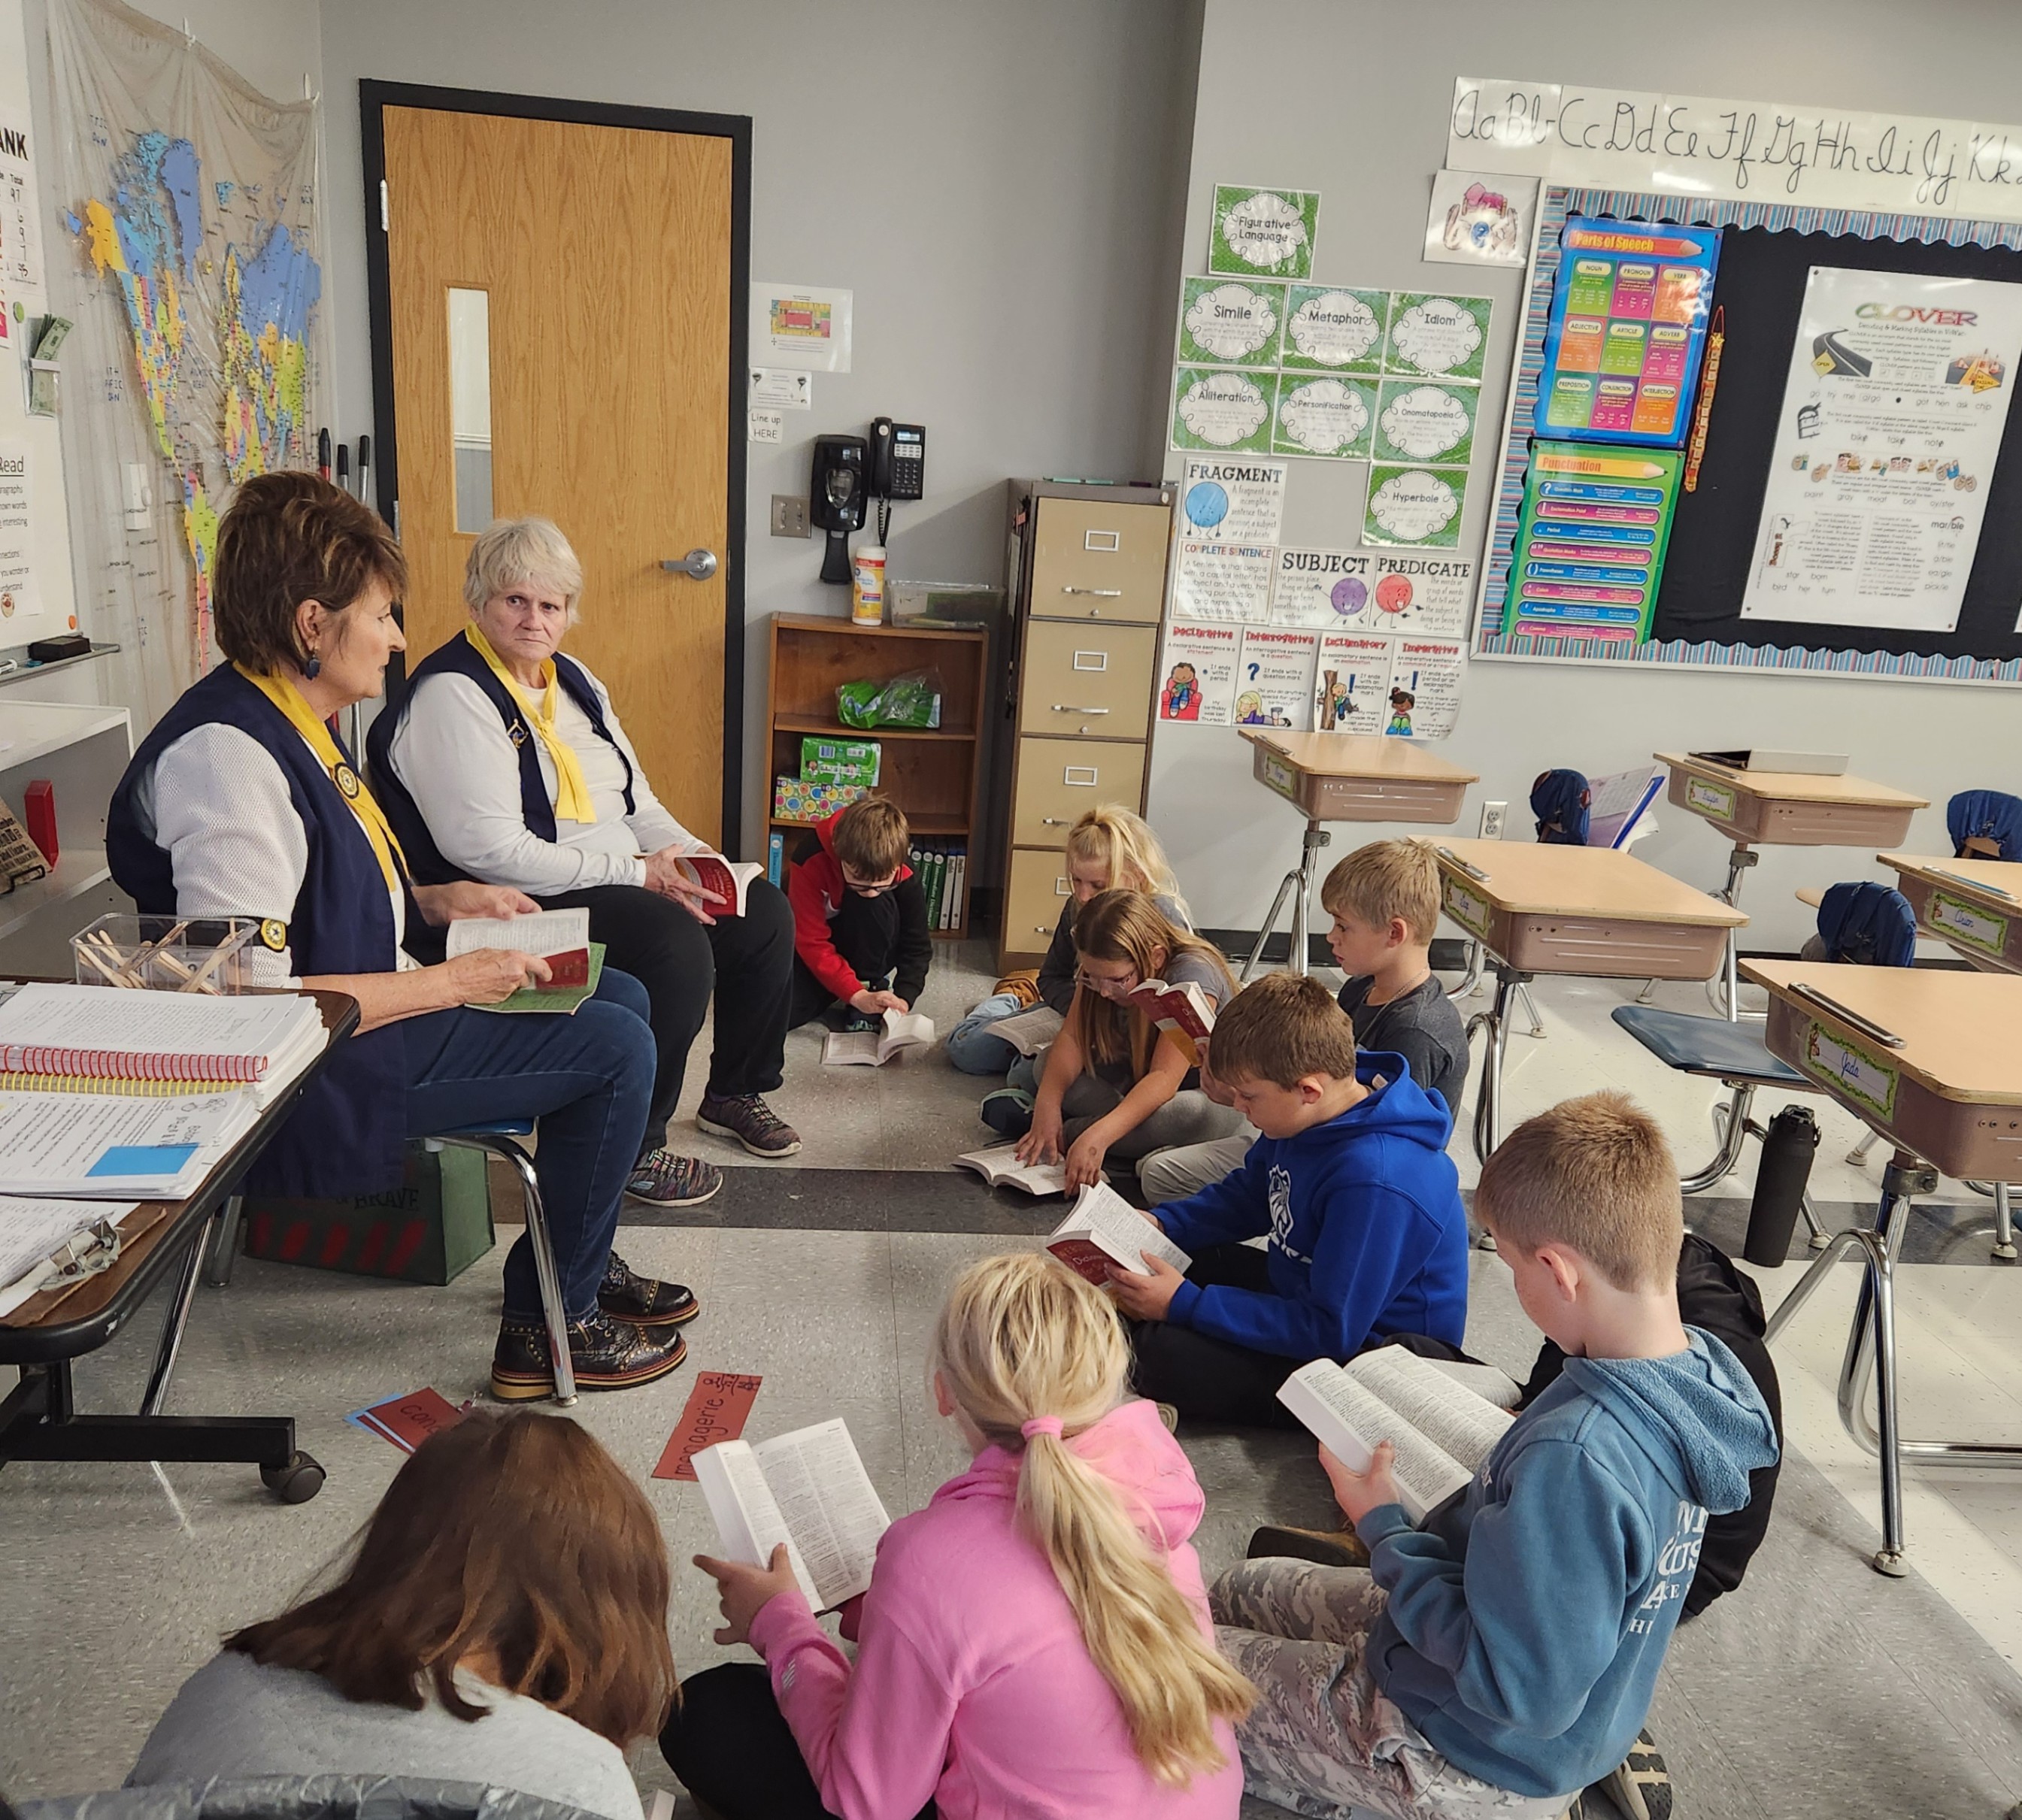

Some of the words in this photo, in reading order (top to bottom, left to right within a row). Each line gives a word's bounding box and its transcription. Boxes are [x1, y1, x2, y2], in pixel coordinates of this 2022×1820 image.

[1238, 216, 1291, 231] Figurative
[1238, 229, 1289, 244] Language
[1575, 232, 1603, 247] Parts
[1604, 235, 1615, 248] of
[1616, 236, 1654, 252] Speech
[1623, 268, 1652, 276] PRONOUN
[1214, 304, 1252, 319] Simile
[1308, 310, 1365, 326] Metaphor
[1855, 301, 1978, 326] CLOVER
[1424, 313, 1457, 326] Idiom
[1570, 323, 1599, 332] ADJECTIVE
[1616, 326, 1638, 335] ARTICLE
[1558, 380, 1590, 389] PREPOSITION
[1601, 383, 1632, 392] CONJUNCTION
[1198, 390, 1254, 403] Alliteration
[1643, 387, 1675, 396] INTERJECTION
[1297, 399, 1353, 411] Personification
[751, 413, 768, 422] Line
[771, 416, 781, 425] up
[1401, 408, 1454, 419] Onomatopoeia
[753, 429, 778, 439] HERE
[1542, 456, 1602, 472] Punctuation
[1189, 465, 1282, 483] FRAGMENT
[1238, 486, 1265, 496] fragment
[1240, 498, 1270, 506] incomplete
[1392, 492, 1439, 504] Hyperbole
[1231, 508, 1255, 516] sentence
[1257, 520, 1277, 529] subject
[1282, 552, 1370, 574] SUBJECT
[1378, 558, 1471, 577] PREDICATE
[1206, 571, 1232, 580] captal
[1173, 625, 1233, 640] Declarative
[1245, 631, 1314, 645] Interrogative
[1325, 637, 1387, 650] Exclamatory
[1402, 643, 1459, 656] Imperative
[1247, 662, 1260, 681] ?
